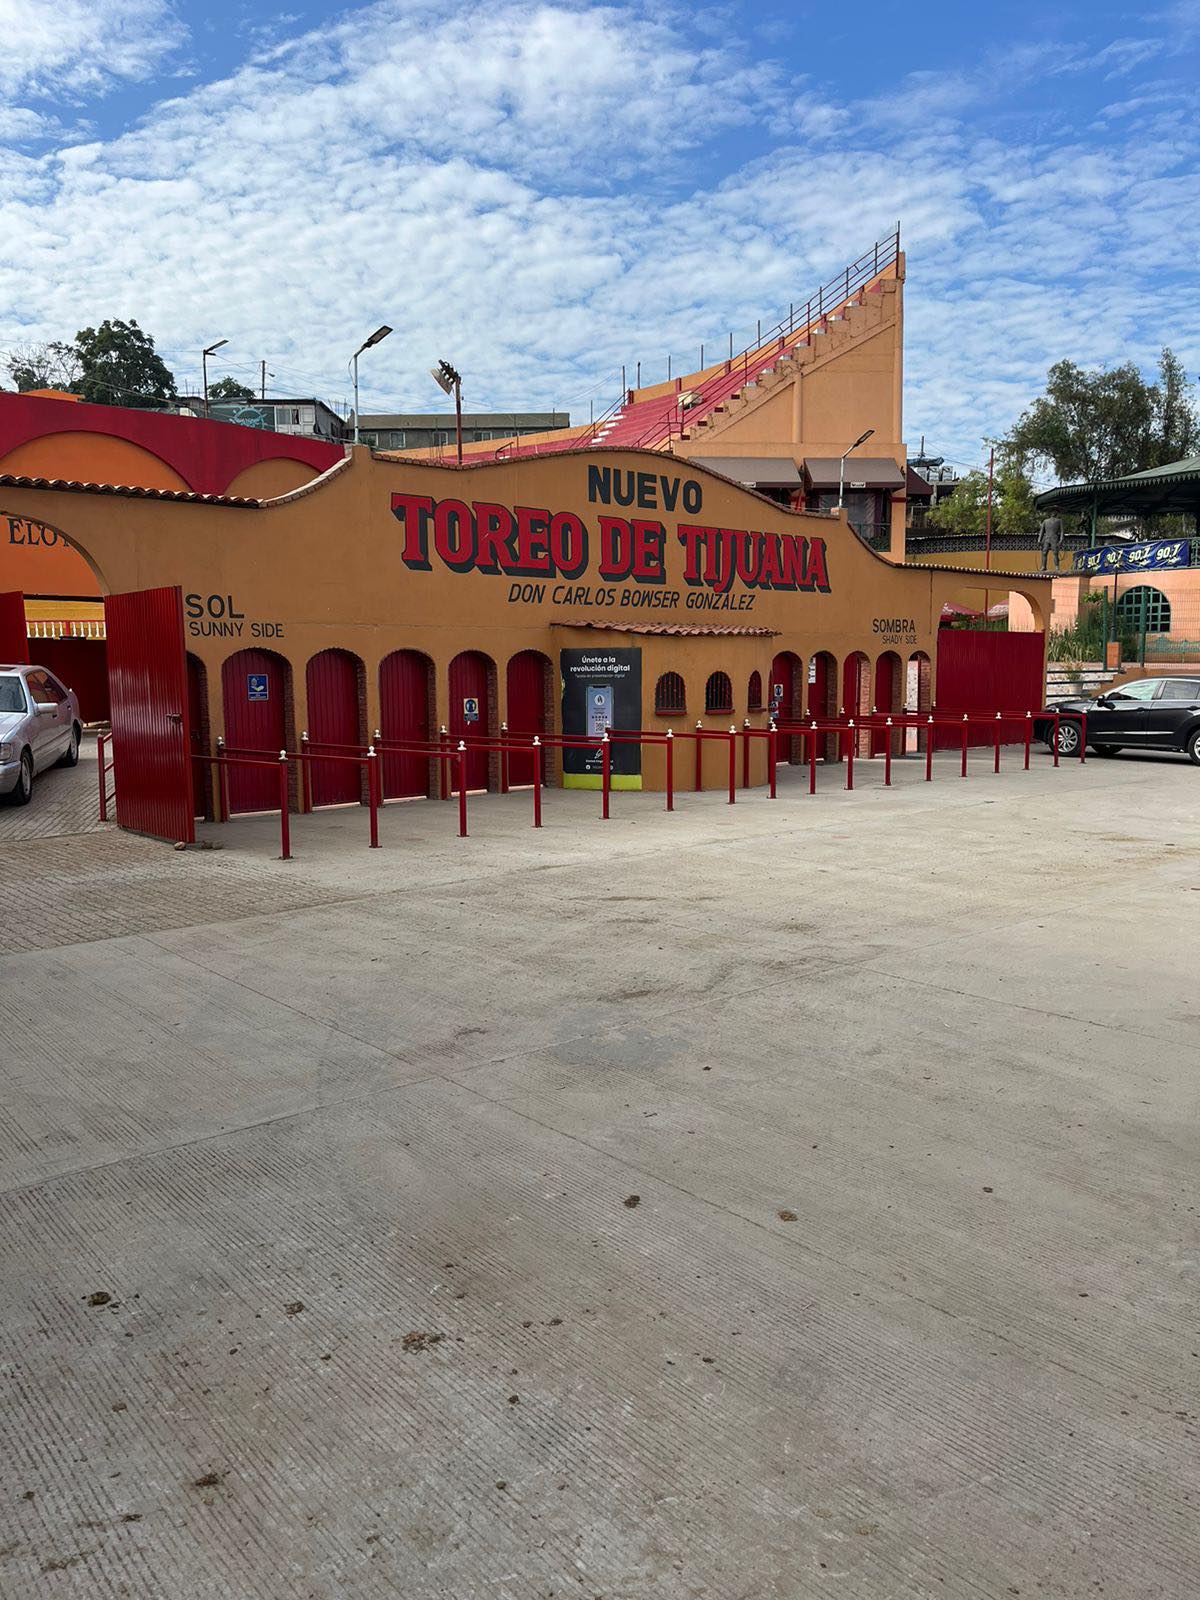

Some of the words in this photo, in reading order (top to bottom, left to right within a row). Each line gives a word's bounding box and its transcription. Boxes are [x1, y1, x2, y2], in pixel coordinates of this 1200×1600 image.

[588, 464, 703, 515] NUEVO
[6, 517, 69, 547] ELO
[391, 492, 589, 580] TOREO
[598, 515, 667, 585] DE
[677, 524, 832, 594] TIJUANA
[1156, 543, 1181, 560] 90.7
[1128, 546, 1150, 563] 90.7
[508, 583, 546, 604] DON
[552, 585, 616, 606] CARLOS
[620, 588, 680, 609] BOWSER
[185, 593, 245, 619] SOL
[189, 621, 243, 637] SUNNY
[251, 622, 285, 638] SIDE
[872, 618, 916, 633] SOMBRA
[882, 634, 902, 645] SHADY
[905, 634, 917, 645] SIDE
[581, 655, 602, 664] Únete
[570, 664, 606, 672] revolución
[607, 664, 630, 673] digital
